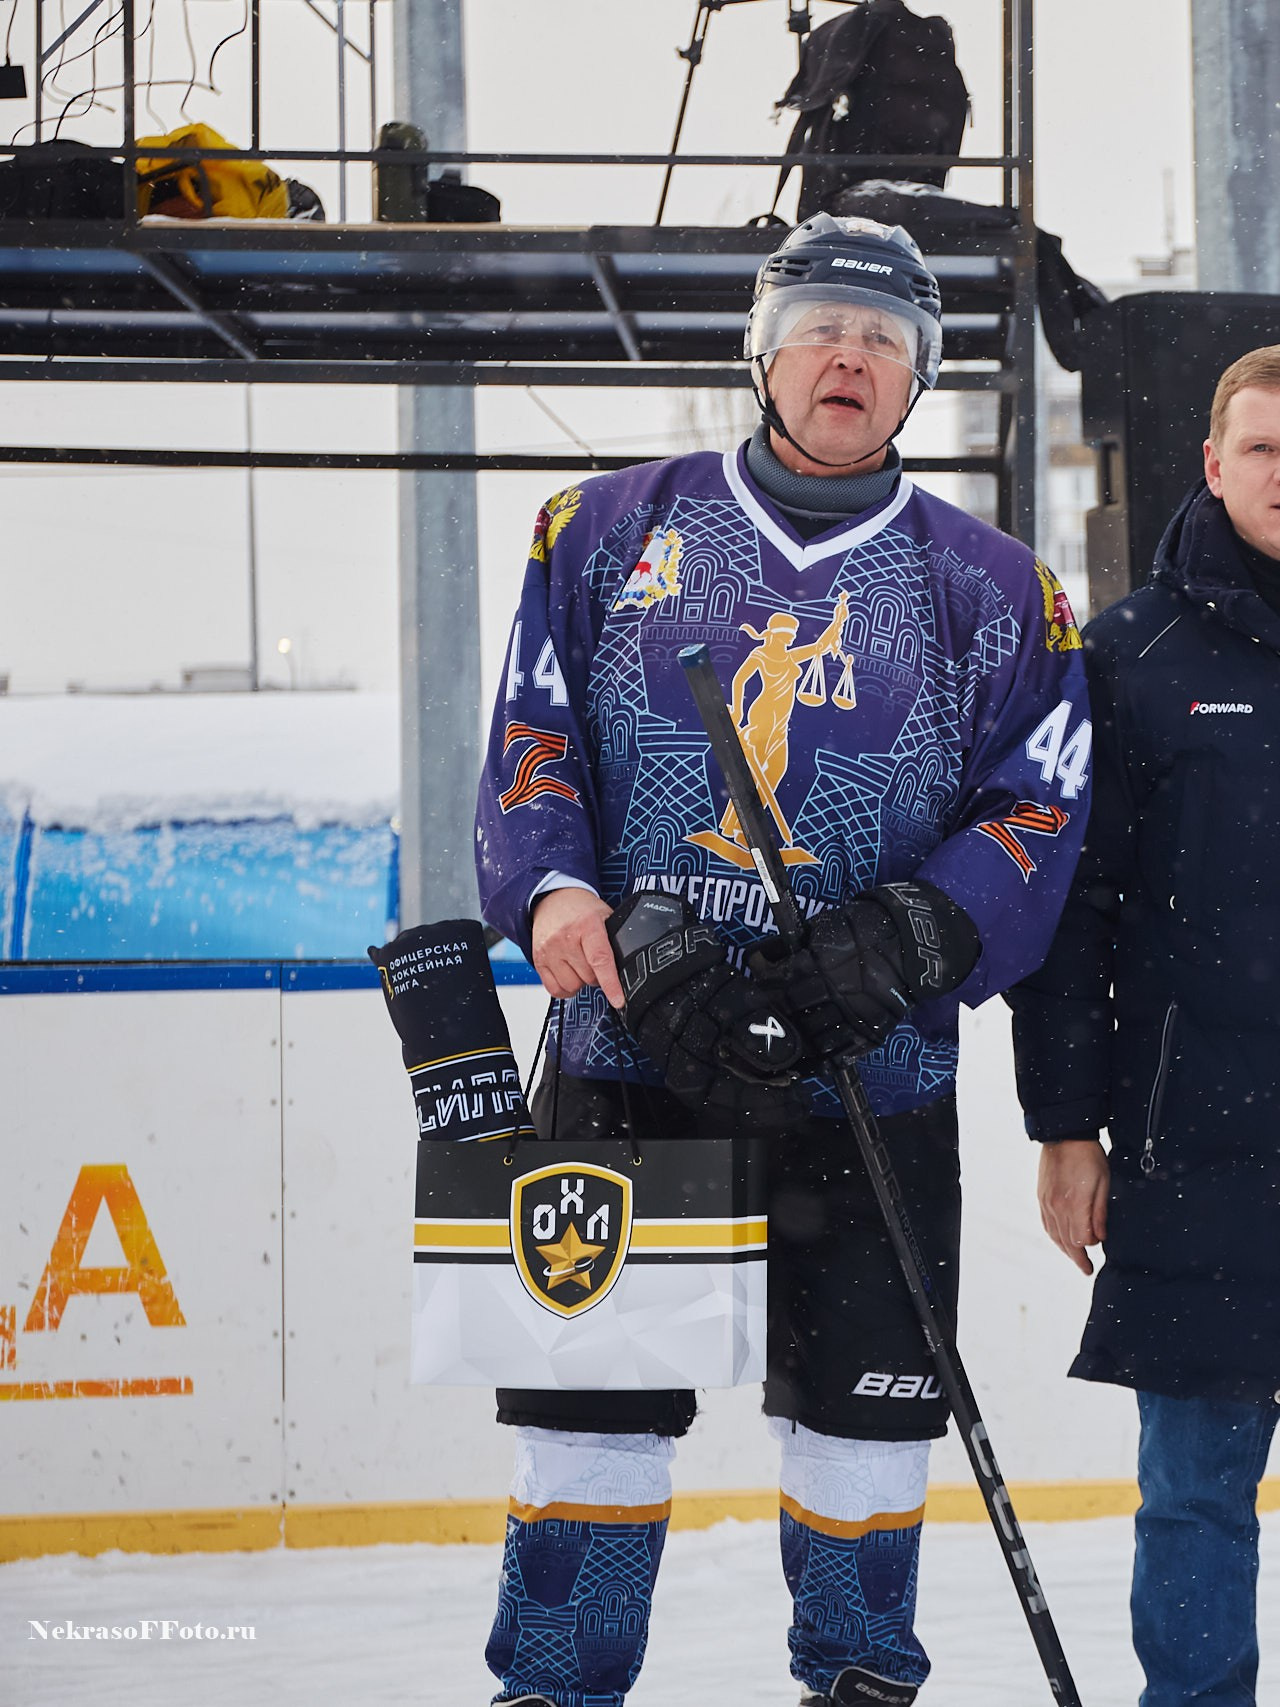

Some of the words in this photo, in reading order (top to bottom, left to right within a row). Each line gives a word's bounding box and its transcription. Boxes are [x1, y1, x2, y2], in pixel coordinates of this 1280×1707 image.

[831, 258, 893, 276] BAUER
[1190, 701, 1253, 715] FORWARD
[1026, 700, 1092, 799] 44
[389, 941, 468, 970] ОФИЦЕРСКАЯ
[392, 955, 462, 983] ХОККЕЙНАЯ
[394, 979, 420, 995] ЛИГА
